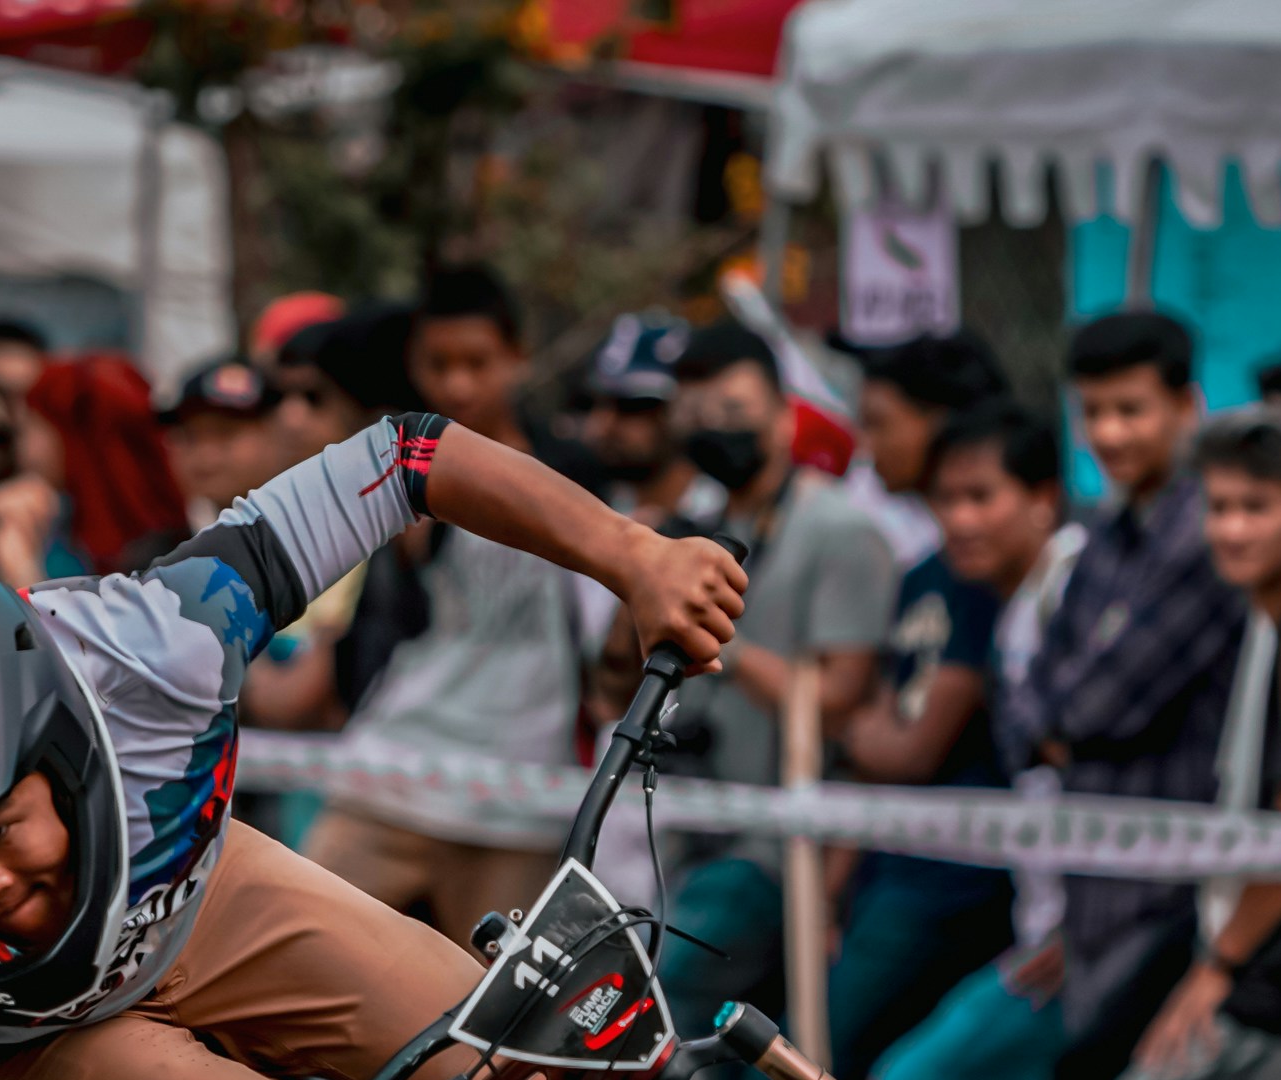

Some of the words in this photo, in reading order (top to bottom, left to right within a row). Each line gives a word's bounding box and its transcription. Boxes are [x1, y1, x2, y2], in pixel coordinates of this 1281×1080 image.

[513, 935, 578, 998] 11
[574, 987, 603, 1026] PUMP
[583, 985, 620, 1029] TRACK
